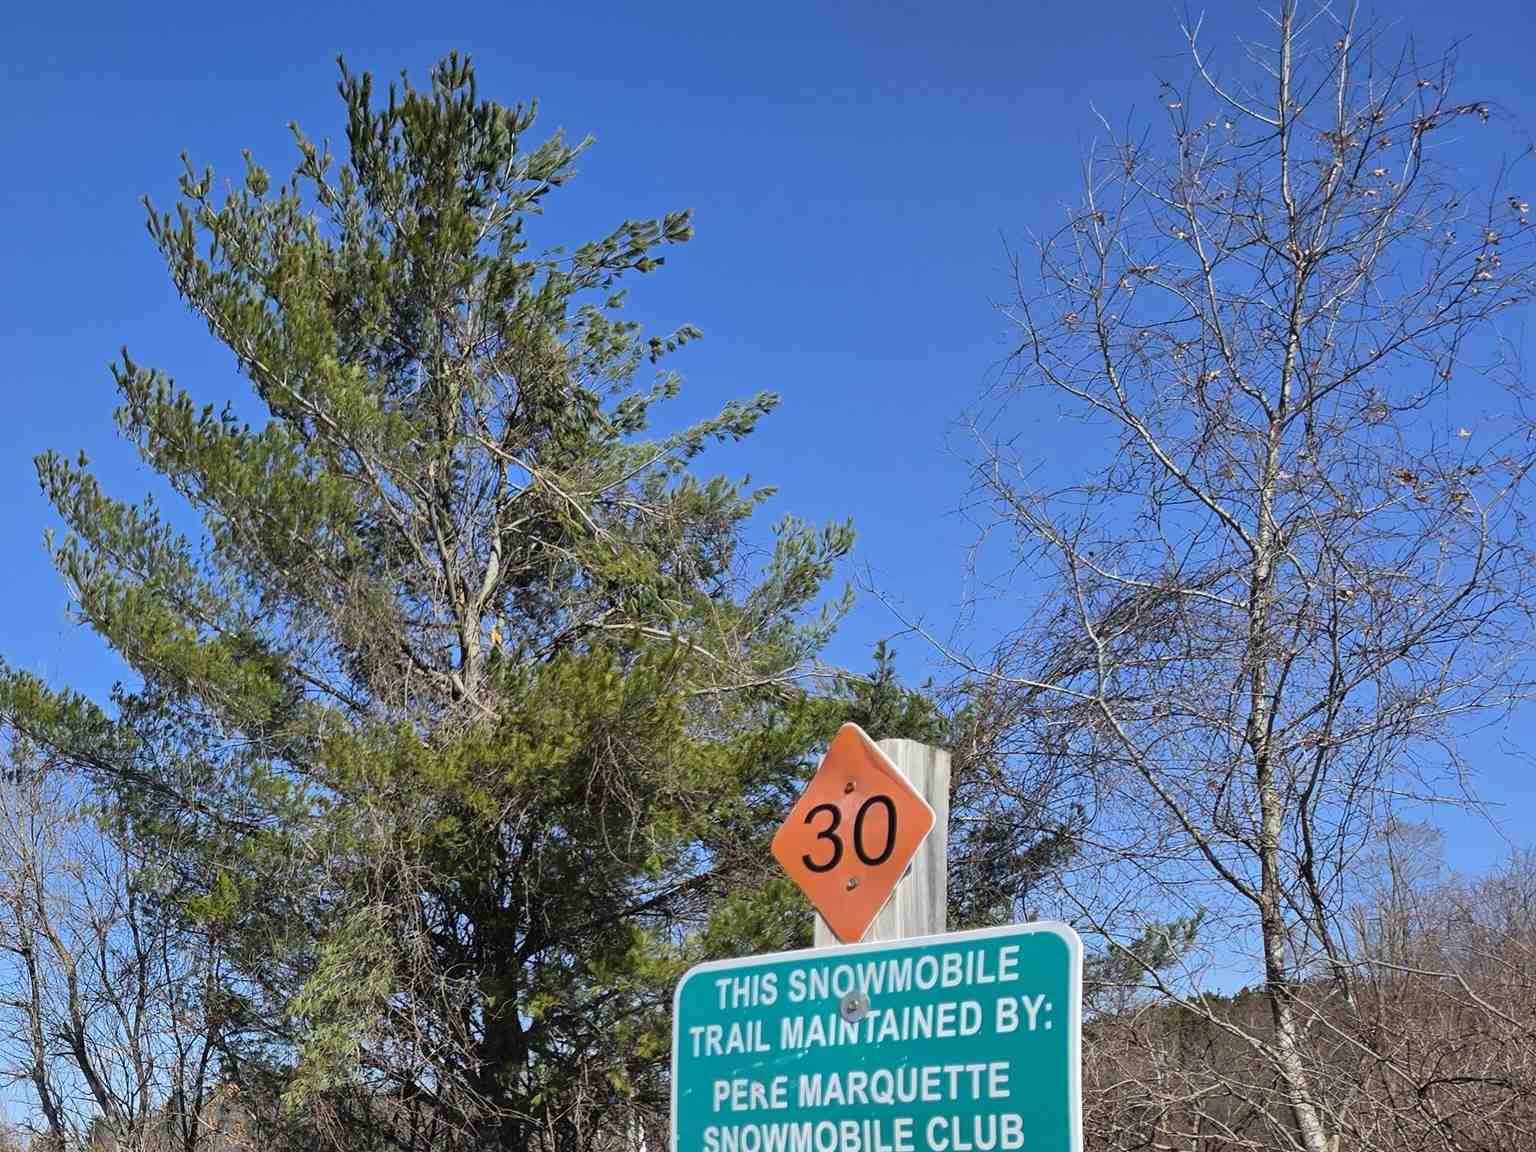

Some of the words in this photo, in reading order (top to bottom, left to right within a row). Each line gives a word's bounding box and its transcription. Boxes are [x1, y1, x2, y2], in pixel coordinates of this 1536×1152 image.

[802, 795, 897, 873] 30
[716, 973, 779, 1009] THIS
[788, 945, 1019, 1002] SNOWMOBILE
[689, 1021, 770, 1058] TRAIL
[781, 1001, 982, 1050] MAINTAINED
[996, 994, 1053, 1034] BY:
[713, 1075, 788, 1112] PERE
[799, 1062, 1011, 1107] MARQUETTE
[926, 1114, 1025, 1151] CLUB
